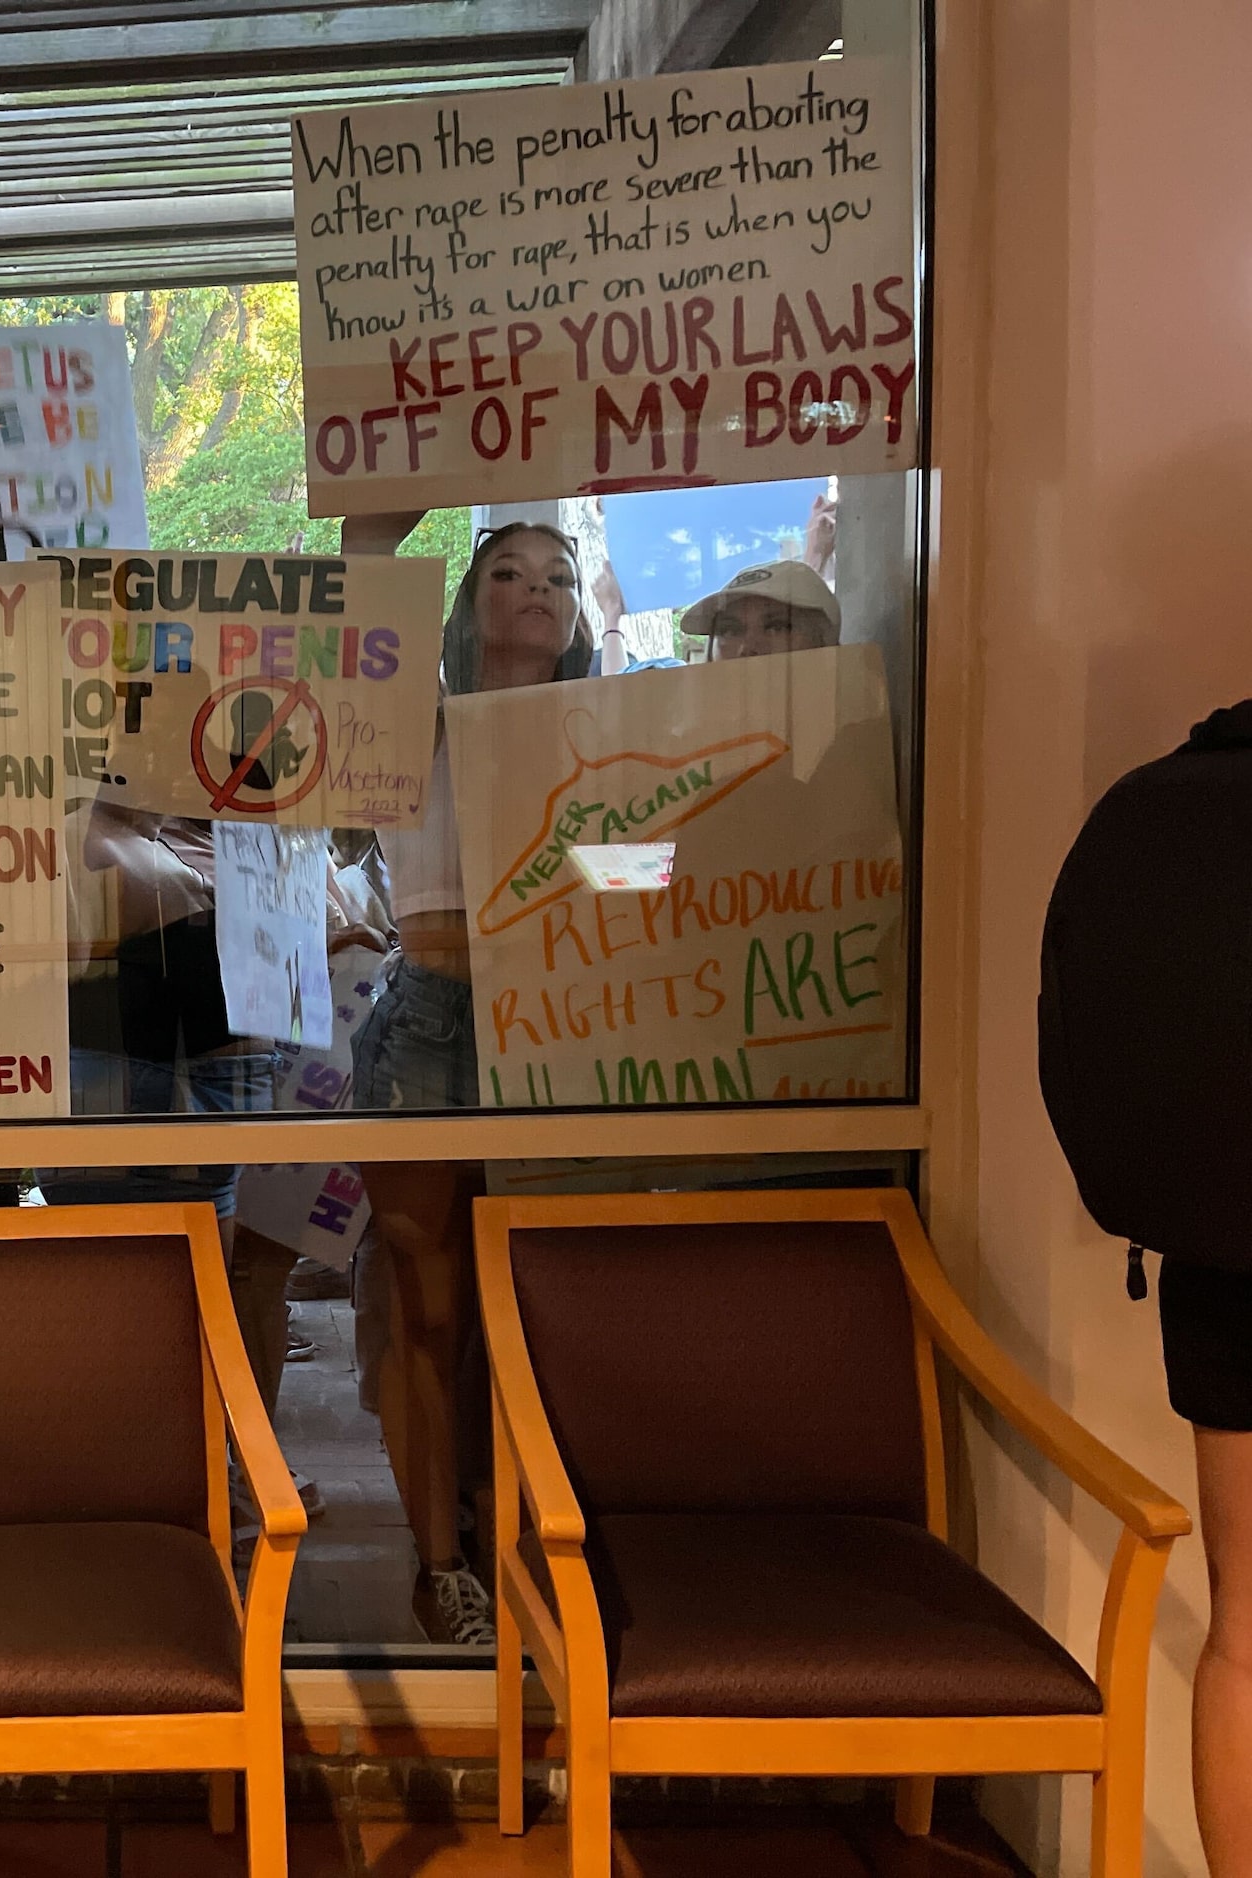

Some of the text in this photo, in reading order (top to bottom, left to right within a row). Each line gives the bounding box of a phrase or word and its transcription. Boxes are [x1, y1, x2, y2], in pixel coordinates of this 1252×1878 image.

[296, 70, 869, 186] When the penalty for aborting
[310, 137, 881, 238] after rape is more severe than the
[315, 198, 872, 303] penalty for rape, that is when you
[325, 301, 406, 343] know
[469, 292, 494, 316] a
[506, 280, 593, 313] war
[603, 275, 645, 301] on
[390, 276, 916, 402] KEEP YOUR LAWS
[41, 400, 99, 448] BE
[315, 360, 916, 476] OFF OF MY BODY
[61, 617, 401, 681] OUR PENIS
[510, 760, 713, 901] NEVER AGAIN
[491, 922, 883, 1055] RIGHTS ARE
